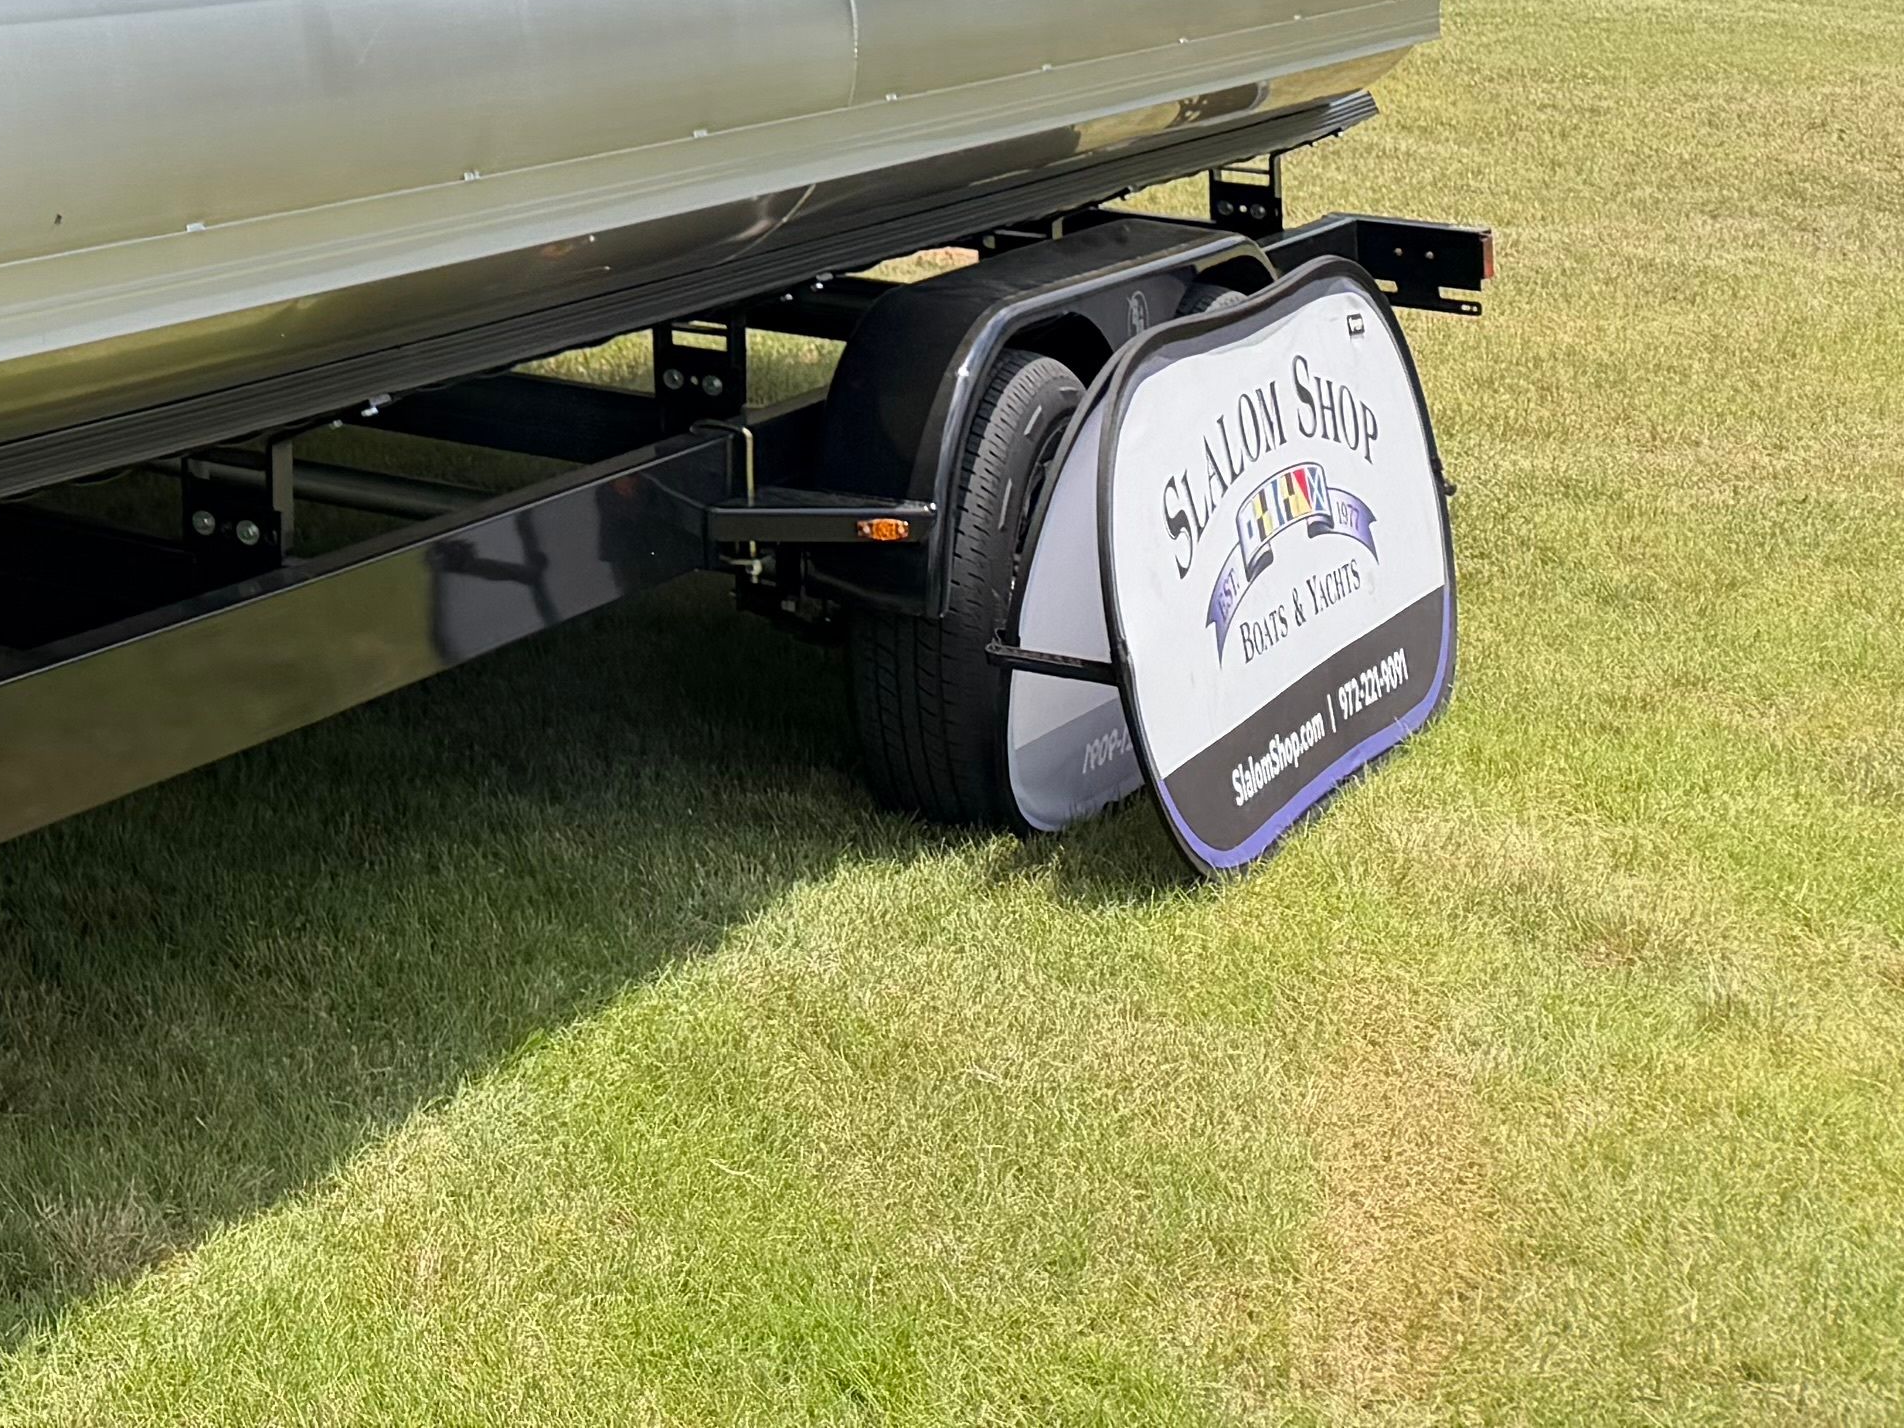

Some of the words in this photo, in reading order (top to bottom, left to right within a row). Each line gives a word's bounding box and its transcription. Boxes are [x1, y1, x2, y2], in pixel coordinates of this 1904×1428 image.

[1163, 381, 1287, 579] SLALOM
[1292, 355, 1378, 464] SHOP
[1336, 501, 1360, 531] 1977
[1239, 605, 1289, 664] BOATS
[1292, 588, 1306, 627] &
[1306, 559, 1361, 615] YACHTS
[1232, 713, 1325, 806] SlalomShop.com
[1338, 648, 1409, 720] 972-221-9091
